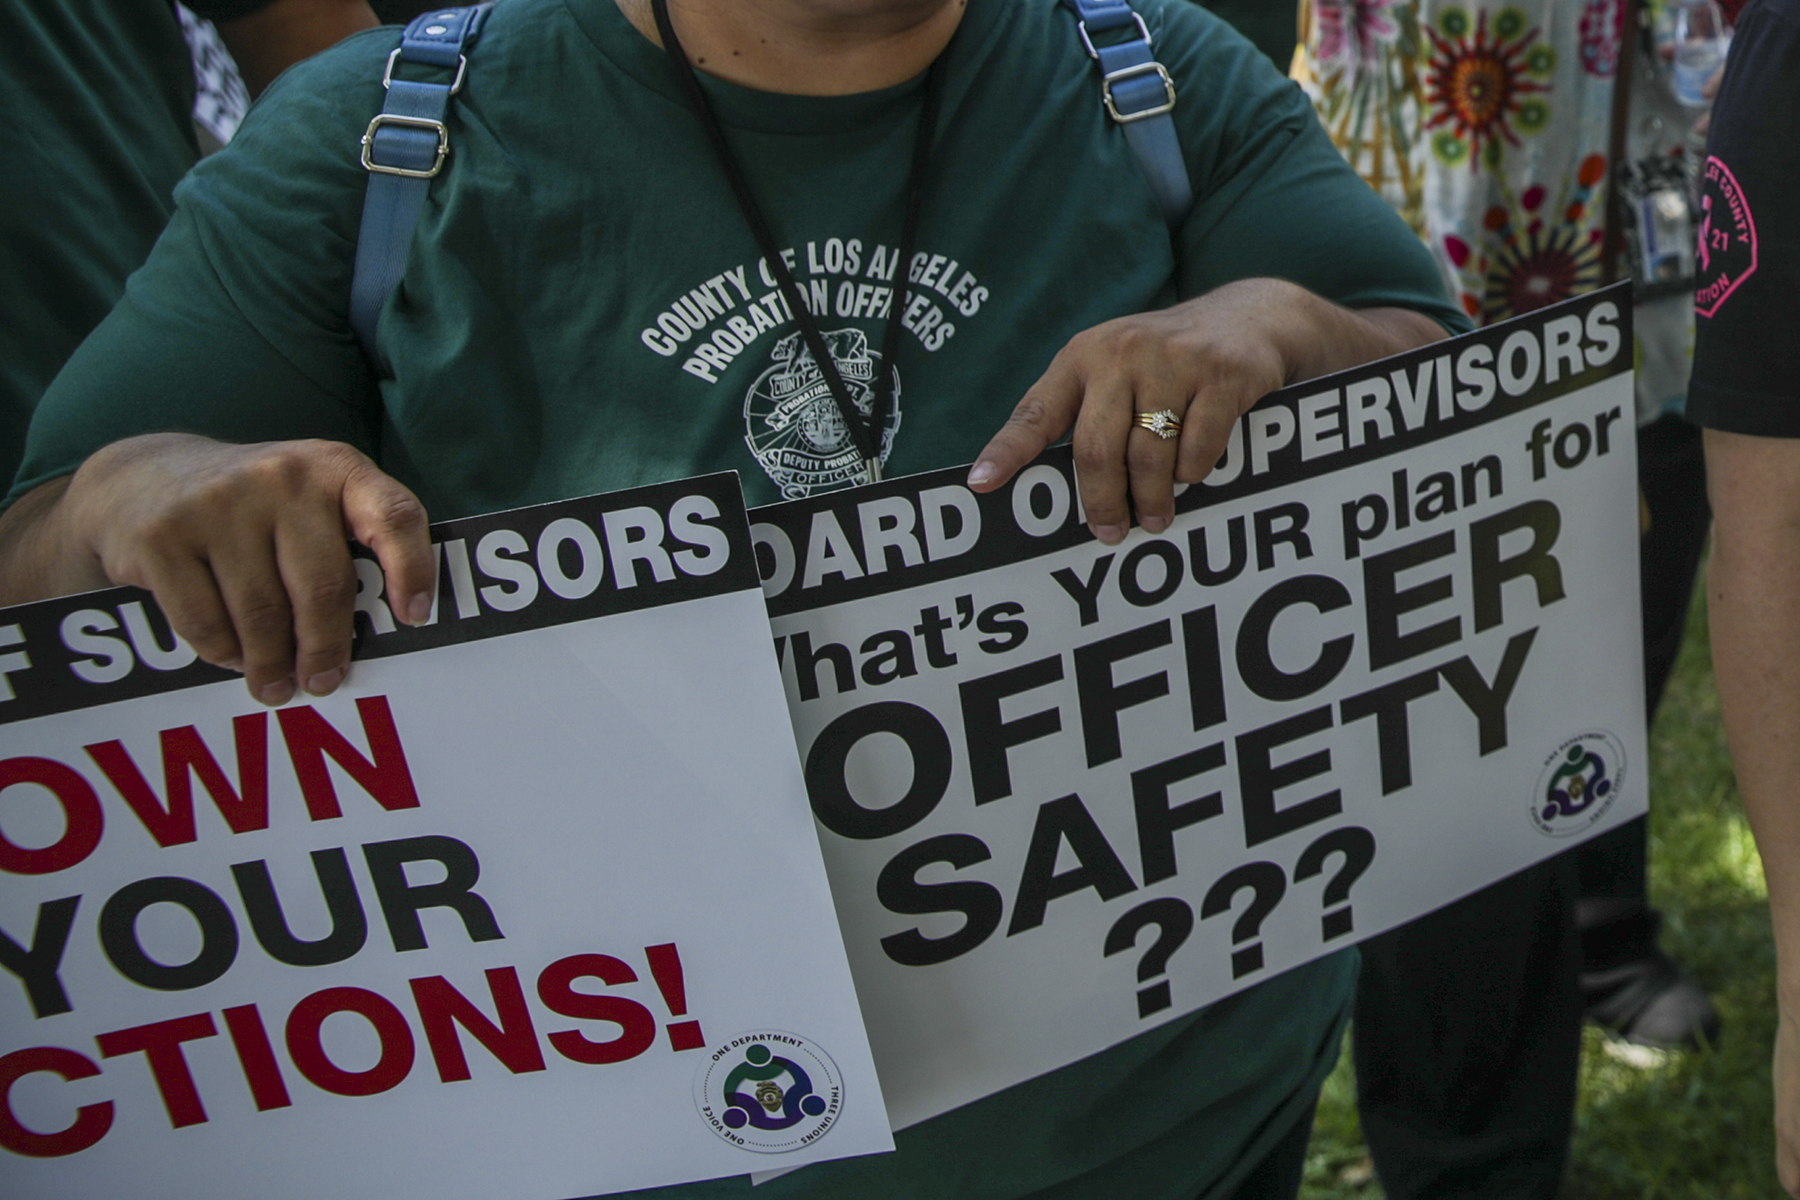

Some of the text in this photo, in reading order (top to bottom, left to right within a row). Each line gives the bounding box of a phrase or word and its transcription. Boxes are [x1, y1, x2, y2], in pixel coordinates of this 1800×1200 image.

[1711, 228, 1729, 251] 21
[1719, 176, 1749, 244] COUNTY
[640, 265, 753, 357] COUNTY
[807, 237, 862, 276] LOS
[774, 371, 806, 395] COUNTY
[783, 452, 820, 471] DEPUTY
[796, 461, 865, 484] OFFICER
[748, 484, 981, 598] OARD
[773, 404, 1621, 702] hat's YOUR plan for
[804, 498, 1567, 840] OFFICER
[0, 694, 421, 876] OWN
[876, 625, 1540, 967] SAFETY
[0, 834, 506, 1021] YOUR
[1103, 825, 1377, 1020] ???
[711, 1033, 804, 1062] ONE DEPARTMENT
[702, 1105, 745, 1146] ONE VOICE
[800, 1085, 839, 1145] THREE UNIONS
